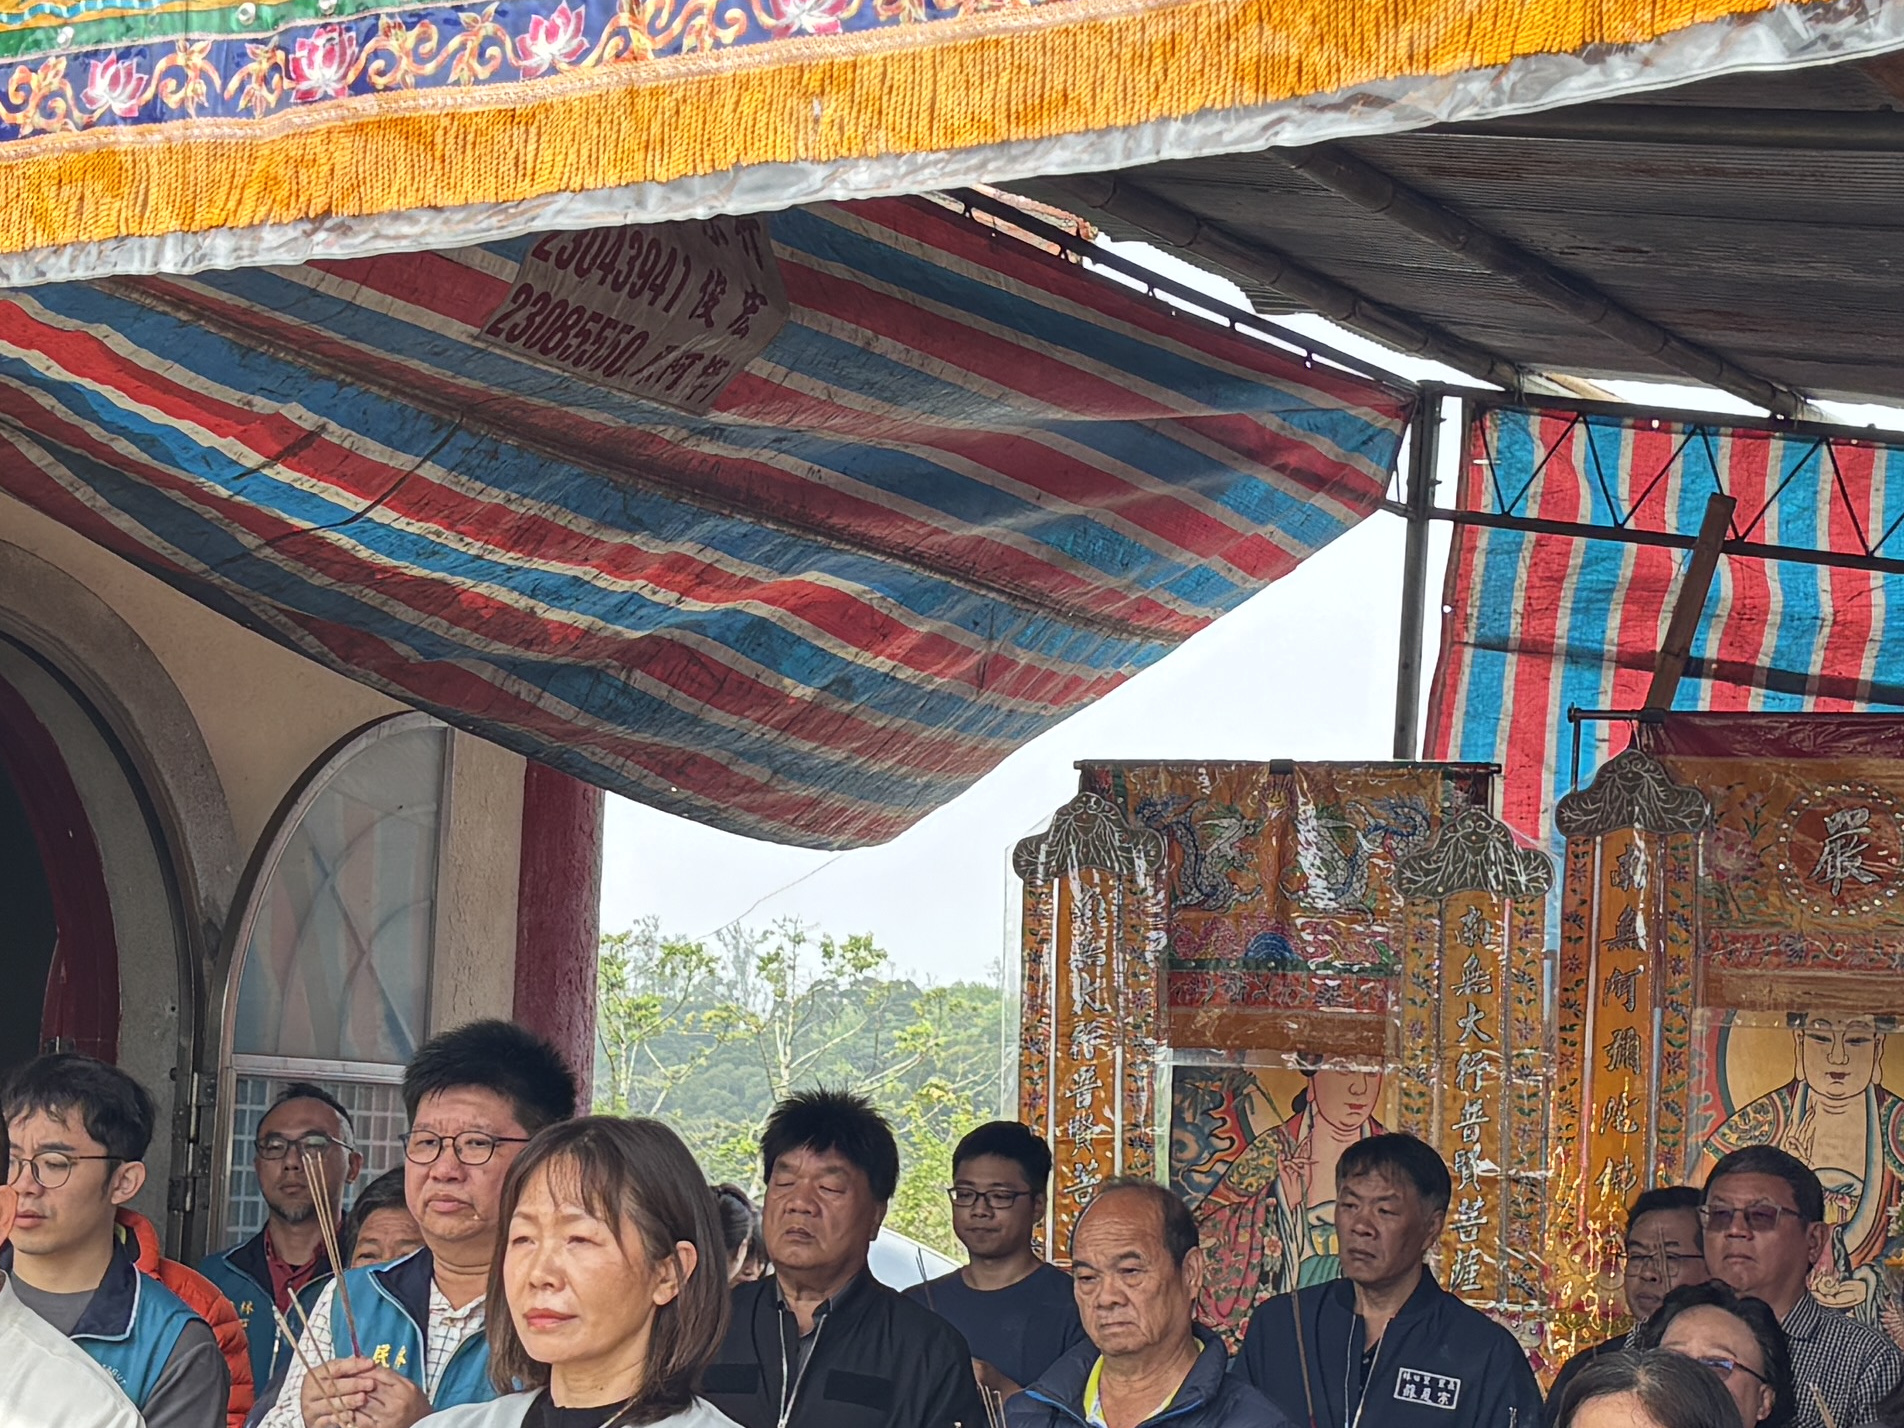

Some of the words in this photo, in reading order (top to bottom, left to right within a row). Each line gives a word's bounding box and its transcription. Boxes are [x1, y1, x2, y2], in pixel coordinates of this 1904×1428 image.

[1446, 903, 1496, 1296] 南無大行普賢菩薩
